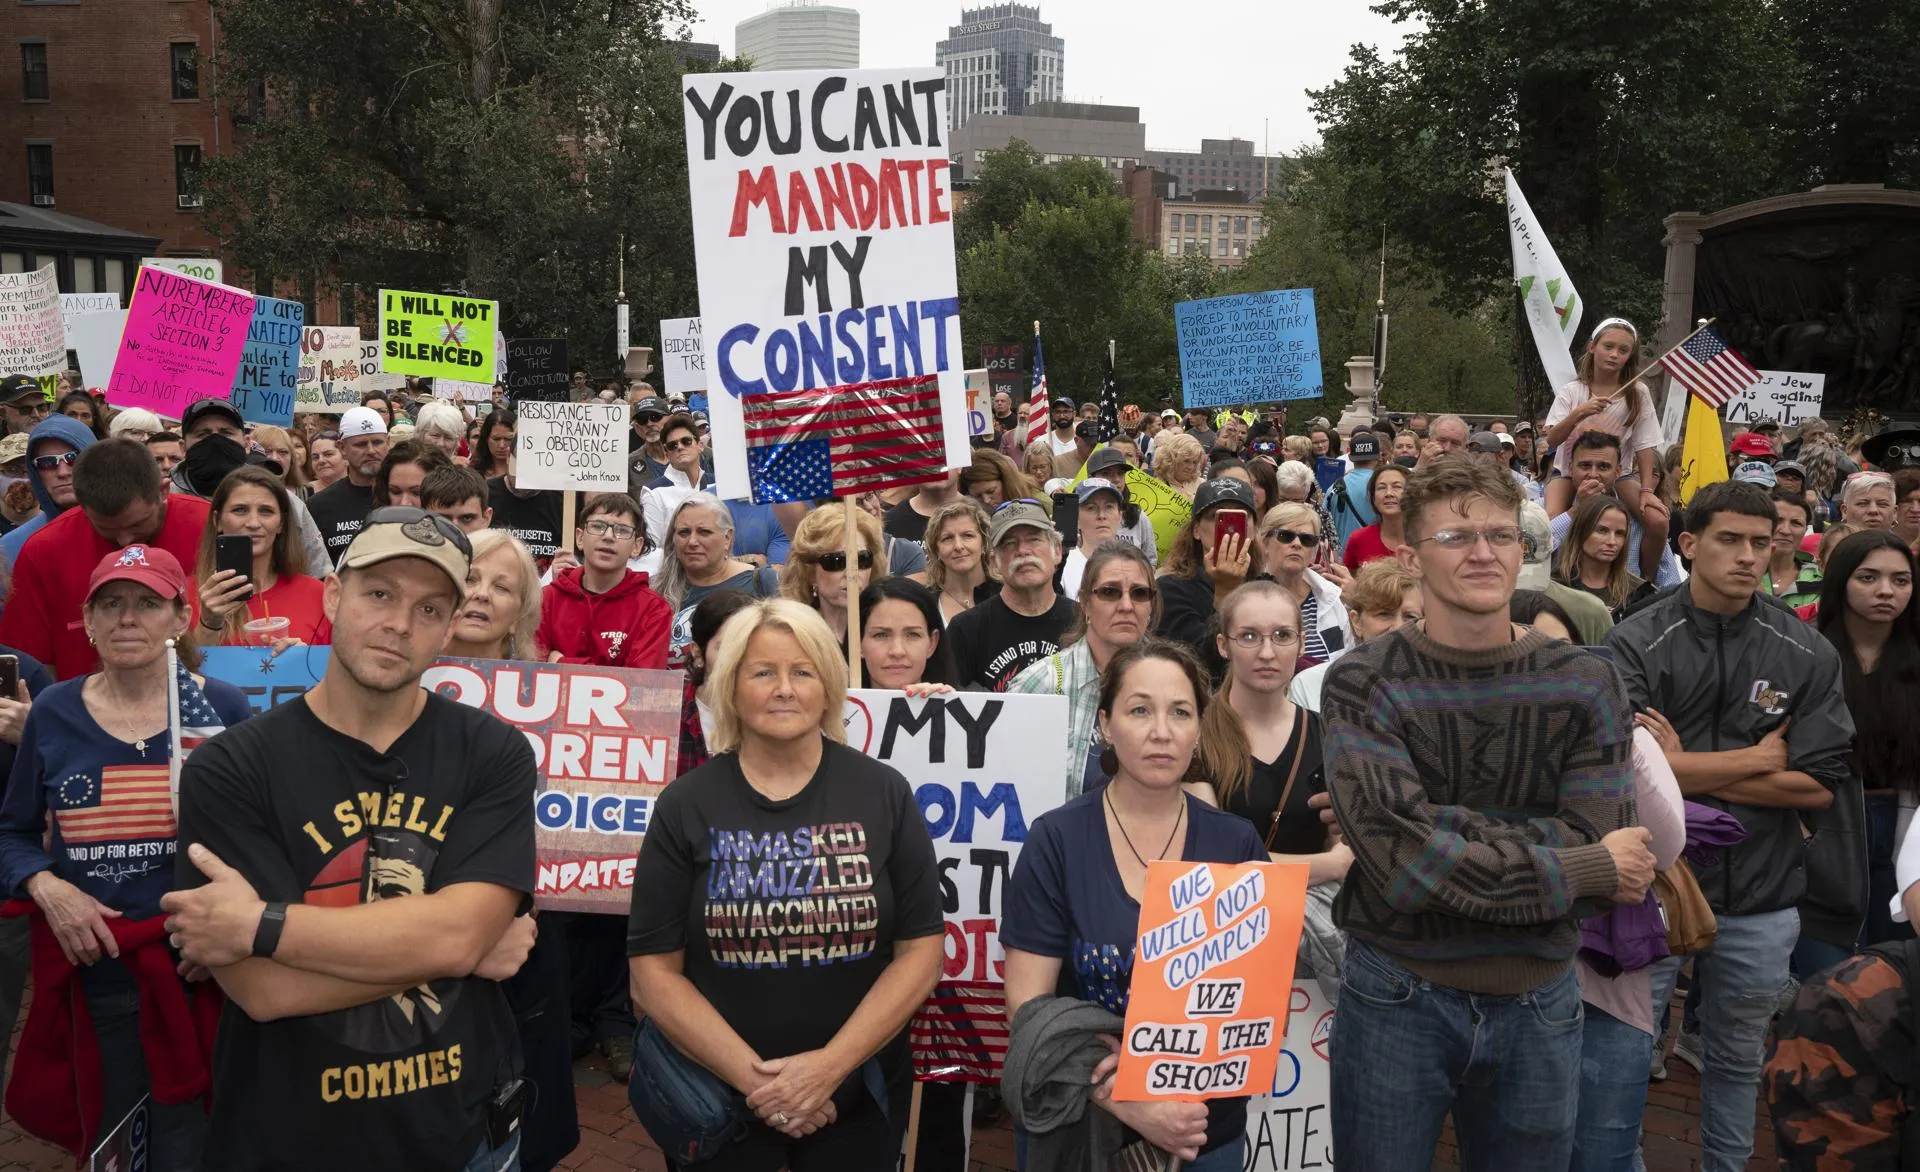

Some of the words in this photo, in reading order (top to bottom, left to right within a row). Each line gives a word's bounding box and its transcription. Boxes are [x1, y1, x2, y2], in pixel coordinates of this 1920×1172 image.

[960, 25, 978, 35] STATE
[979, 22, 1000, 32] STREET
[685, 82, 801, 160] YOU
[811, 76, 945, 152] CANT
[728, 158, 950, 237] MANDATE
[784, 236, 872, 316] MY
[138, 272, 253, 317] NUREMBERG
[1206, 296, 1243, 310] PERSON
[1246, 293, 1285, 306] CANNOT
[1291, 290, 1303, 300] BE
[152, 301, 219, 332] ARTICLE
[220, 317, 231, 334] 6
[274, 302, 302, 321] are
[386, 294, 392, 312] I
[401, 296, 444, 316] WILL
[451, 301, 491, 321] NOT
[1181, 313, 1224, 328] FORCED
[1228, 312, 1239, 322] TO
[1244, 305, 1272, 319] TAKE
[1278, 302, 1300, 314] ANY
[150, 322, 209, 351] SECTION
[212, 336, 224, 352] 3
[248, 321, 299, 346] NATED
[386, 319, 412, 338] BE
[1182, 326, 1210, 338] KIND
[1213, 324, 1229, 334] OF
[1232, 314, 1309, 332] INVOLUNTARY
[127, 339, 140, 350] No
[506, 340, 552, 358] FOLLOW
[664, 338, 700, 352] BIDEN
[717, 297, 960, 399] CONSENT
[1184, 339, 1200, 348] OR
[1201, 332, 1277, 346] UNDISCLOSED
[1186, 343, 1265, 358] VACCINATION
[1268, 341, 1284, 352] OR
[1288, 340, 1304, 352] BE
[386, 340, 484, 368] SILENCED
[524, 358, 551, 368] THE
[984, 358, 1016, 370] LOSE
[1186, 358, 1235, 370] DEPRIVED
[1238, 355, 1255, 366] OF
[1258, 355, 1277, 365] ANY
[1280, 350, 1319, 363] OTHER
[242, 365, 271, 387] ME
[280, 370, 296, 388] to
[320, 360, 360, 382] Masks
[1188, 368, 1220, 380] RIGHT
[1222, 367, 1236, 376] OR
[1189, 377, 1250, 390] INCLUDING
[1253, 374, 1283, 385] RIGHT
[1287, 374, 1302, 382] TO
[1781, 376, 1813, 389] Jew
[112, 373, 124, 392] I
[128, 376, 148, 394] DO
[152, 380, 181, 404] NOT
[322, 382, 361, 406] Vaccine
[996, 384, 1012, 392] LOSE
[1742, 391, 1756, 400] is
[1770, 391, 1822, 404] against
[260, 391, 291, 416] YOU
[519, 401, 592, 422] RESISTANCE
[605, 406, 622, 422] TO
[546, 421, 609, 436] TYRANNY
[522, 436, 534, 450] IS
[546, 436, 619, 453] OBEDIENCE
[535, 452, 554, 467] TO
[568, 452, 602, 468] GOD
[1741, 463, 1765, 473] USA
[599, 472, 620, 482] Knox
[985, 671, 995, 679] I
[990, 646, 1018, 674] STAND
[1018, 640, 1036, 656] FOR
[1040, 640, 1058, 656] THE
[420, 662, 634, 730] OUR
[877, 697, 1004, 769] MY
[304, 820, 334, 855] I
[334, 792, 454, 842] SMELL
[914, 782, 1030, 844] OM
[90, 846, 105, 860] UP
[108, 844, 126, 858] FOR
[128, 842, 164, 858] BETSY
[709, 821, 867, 862] UNMASKED
[707, 854, 874, 899] UNMUZZLED
[1172, 866, 1211, 910] WE
[705, 892, 879, 938] UNVACCINATED
[1141, 912, 1206, 961] WILL
[1216, 872, 1261, 920] NOT
[707, 930, 877, 969] UNAFRAID
[1168, 908, 1268, 990] COMPLY!
[1196, 983, 1242, 1010] WE
[1131, 1027, 1201, 1055] CALL
[1222, 1022, 1270, 1050] THE
[321, 1044, 462, 1103] COMMIES
[1152, 1060, 1247, 1092] SHOTS!
